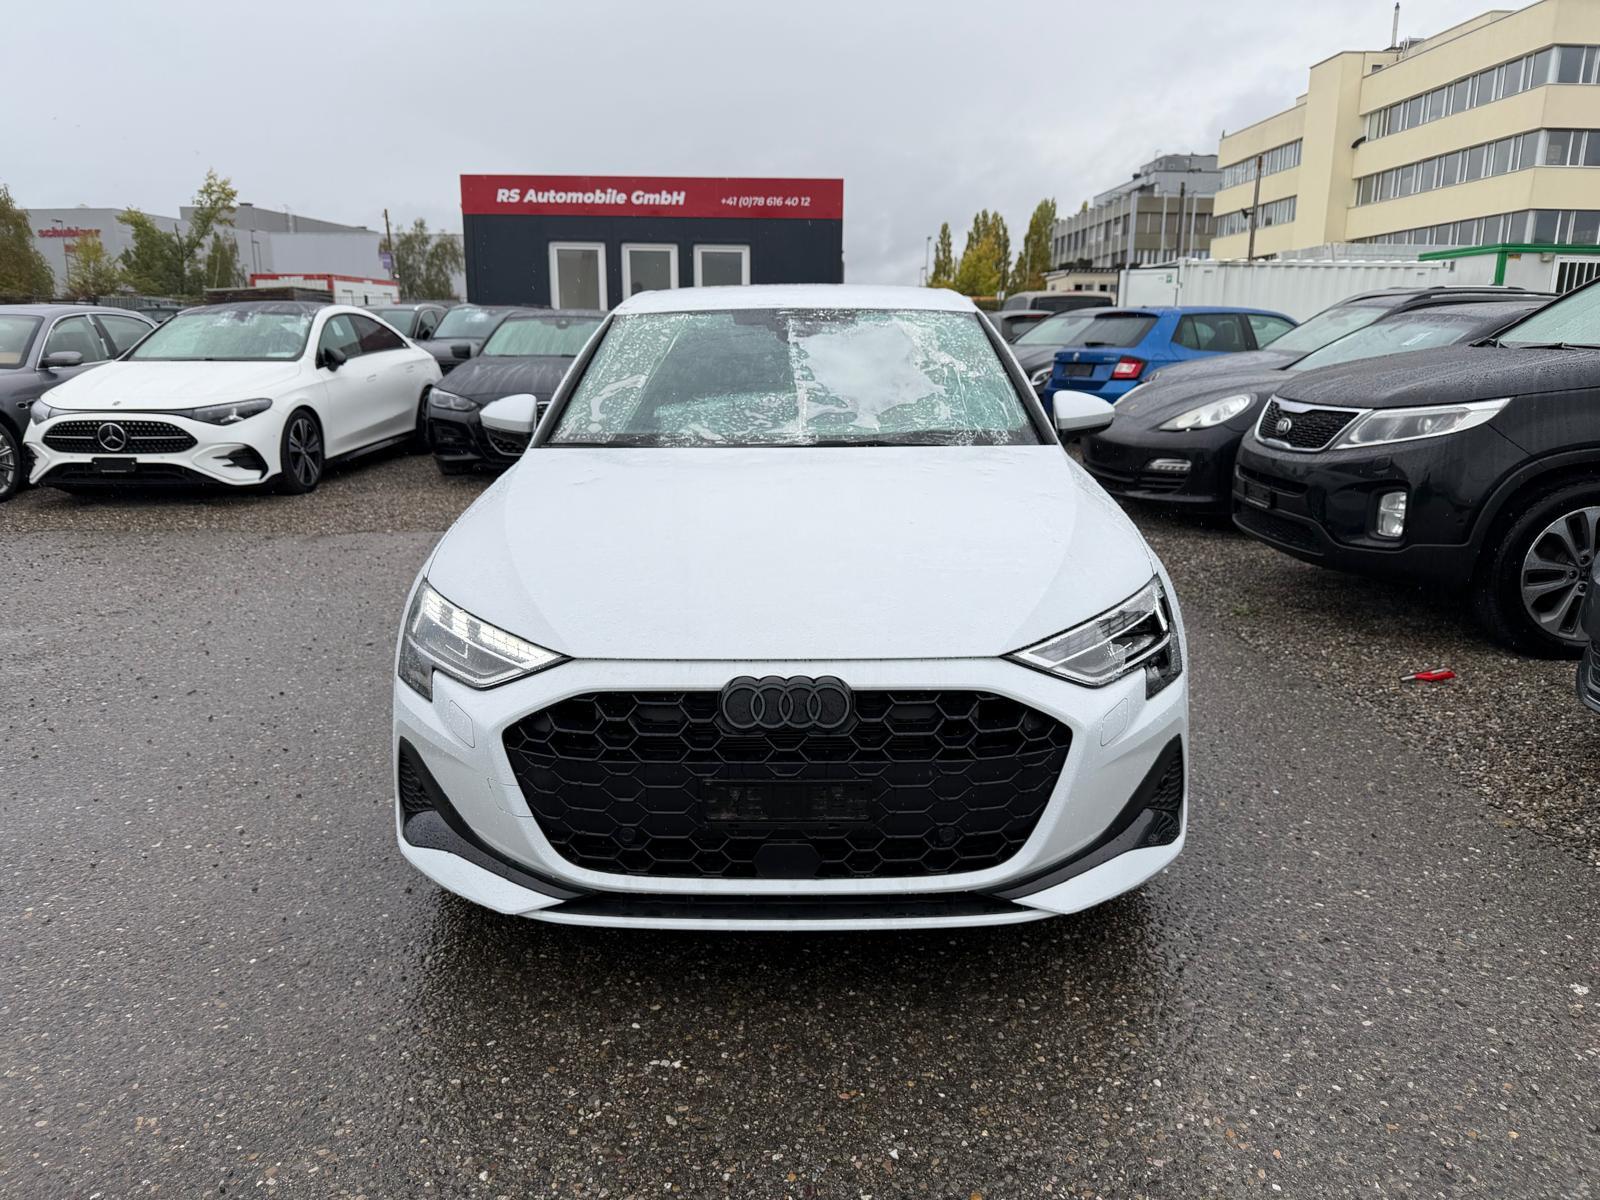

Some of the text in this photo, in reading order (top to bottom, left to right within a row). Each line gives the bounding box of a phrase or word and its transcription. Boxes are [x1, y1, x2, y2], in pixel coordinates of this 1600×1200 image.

[496, 188, 686, 206] RS Automobile GmbH
[721, 195, 811, 208] +41 (0)78 616 40 12
